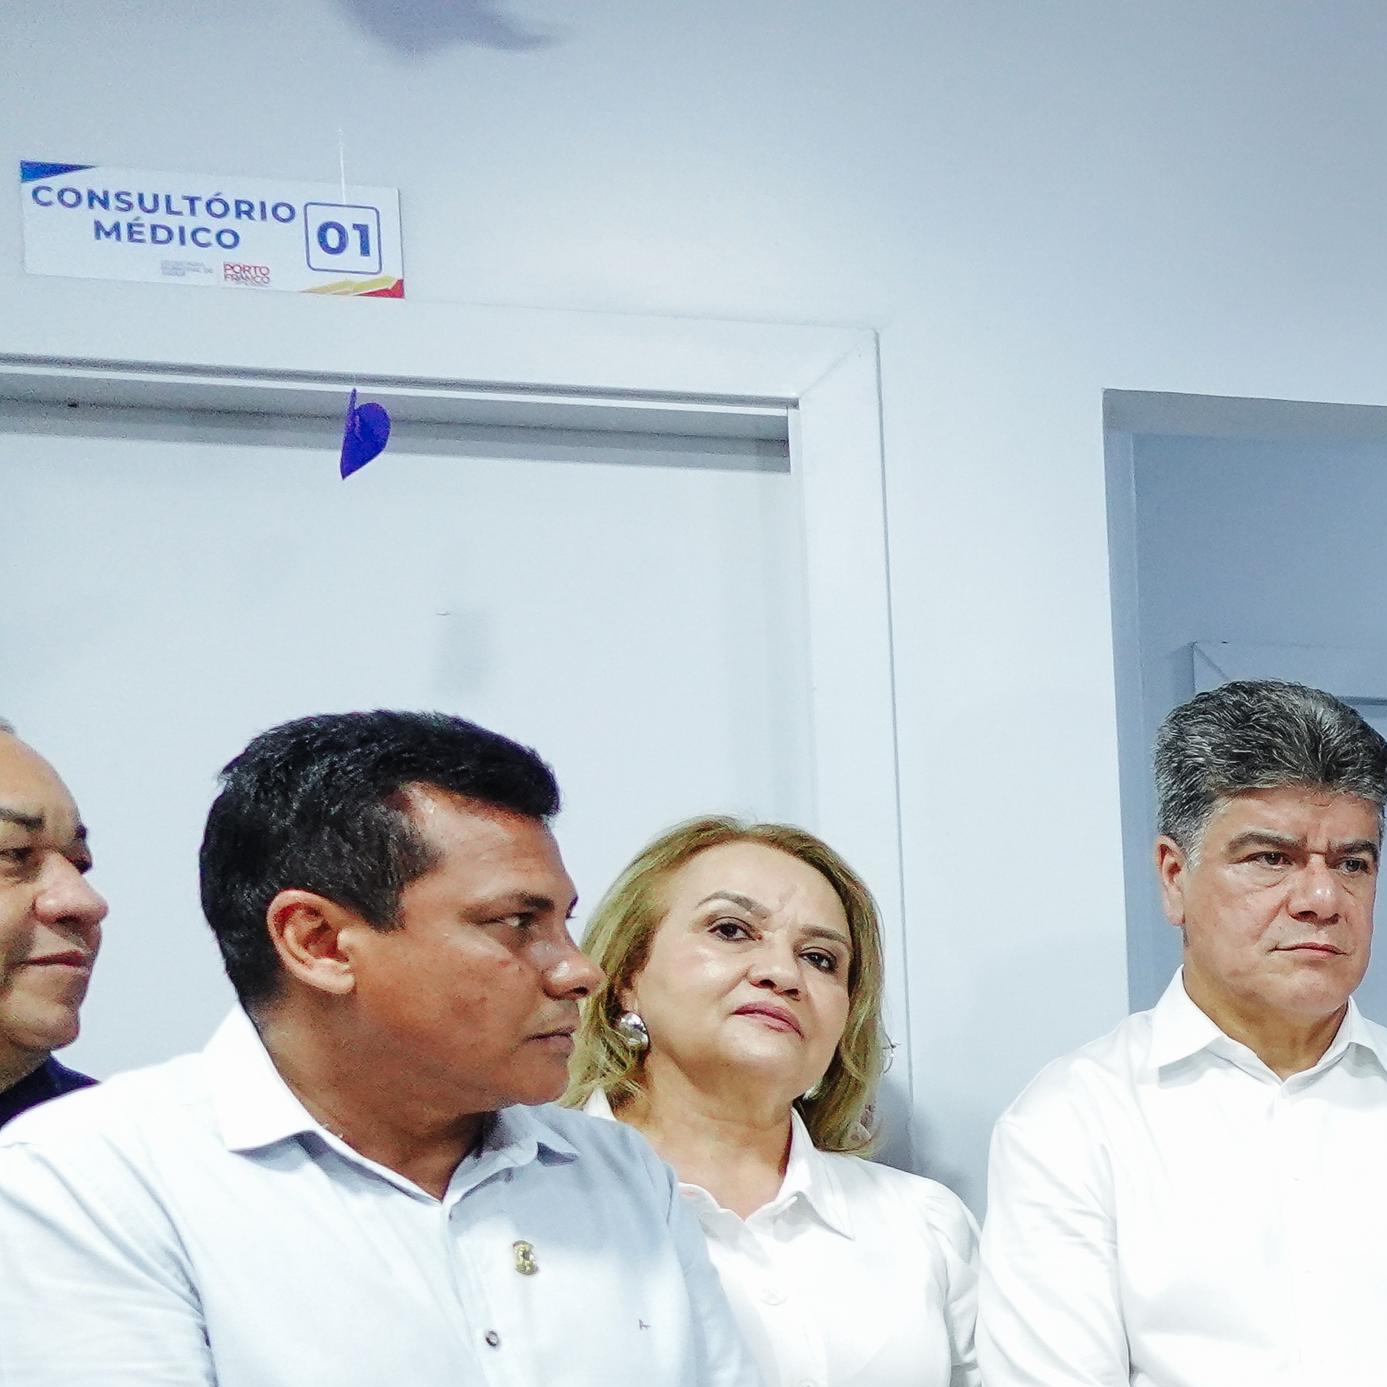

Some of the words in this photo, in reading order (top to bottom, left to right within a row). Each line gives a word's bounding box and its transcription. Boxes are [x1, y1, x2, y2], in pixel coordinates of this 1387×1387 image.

[31, 185, 296, 223] CONSULTÓRIO
[93, 216, 241, 250] MÉDICO
[316, 220, 372, 257] 01
